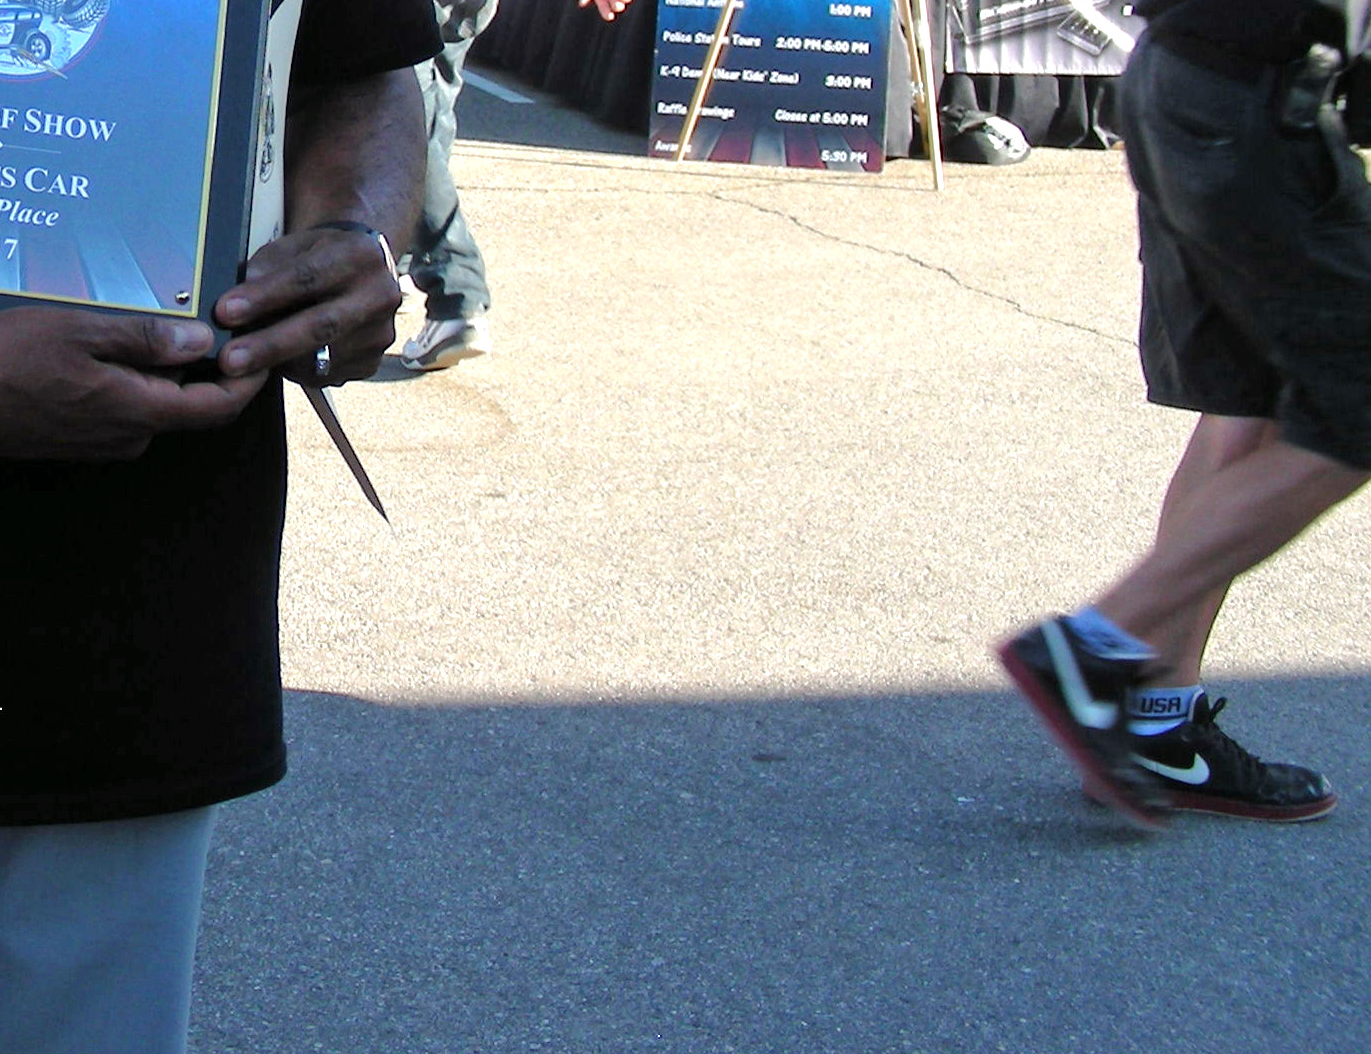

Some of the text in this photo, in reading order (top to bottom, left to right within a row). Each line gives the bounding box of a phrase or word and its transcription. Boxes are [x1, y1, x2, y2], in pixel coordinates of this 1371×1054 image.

[829, 3, 851, 16] 1:00
[854, 5, 872, 18] PM
[663, 30, 693, 43] Police
[732, 33, 761, 47] Tours
[775, 37, 802, 49] 2:00
[851, 42, 870, 54] PM
[853, 77, 872, 90] PM
[696, 106, 735, 120] rawings
[809, 112, 821, 123] at
[822, 112, 848, 125] 5:00
[850, 114, 868, 127] PM
[821, 150, 847, 162] 5:30
[849, 152, 868, 165] PM
[1140, 697, 1181, 714] USA
